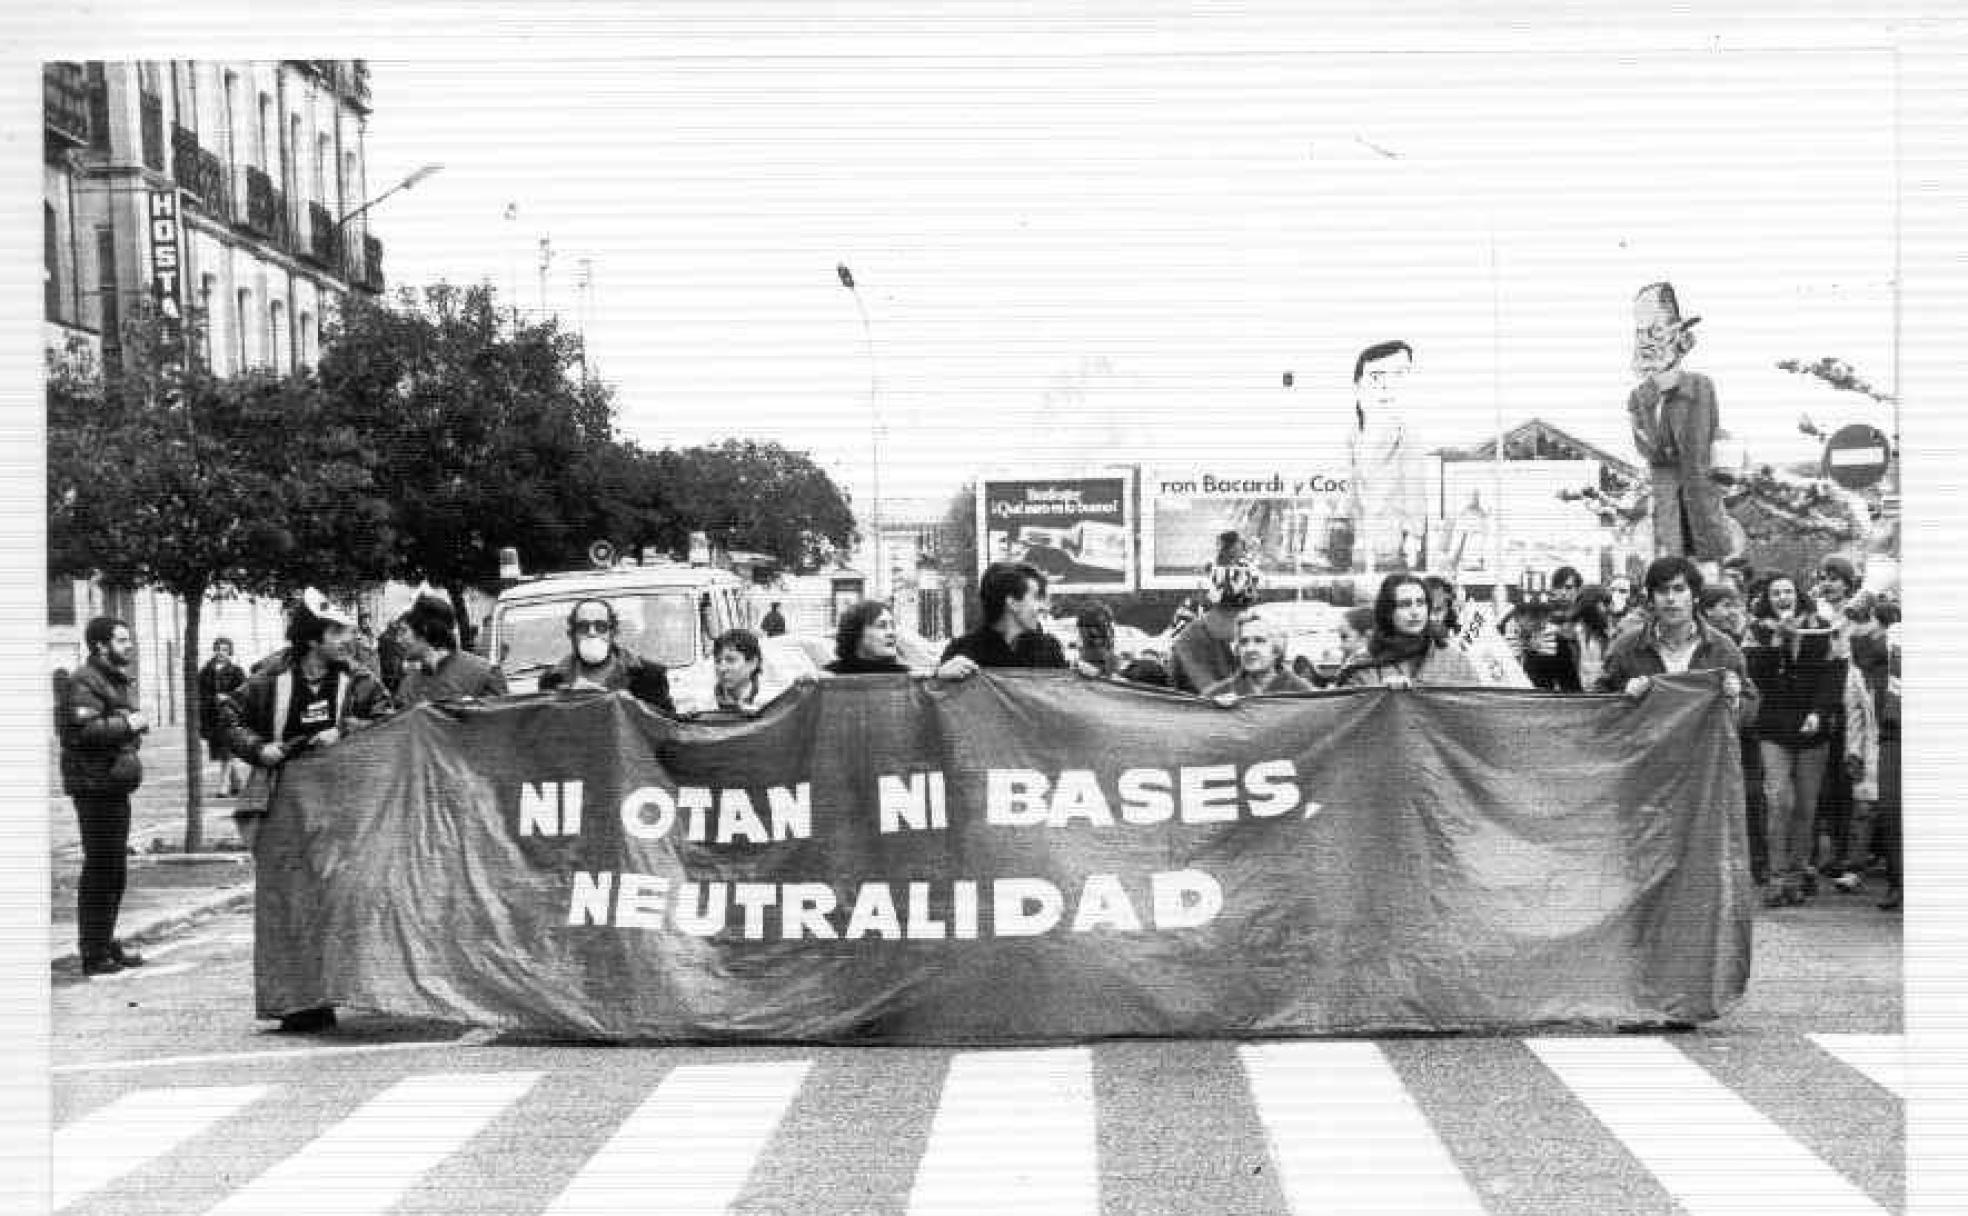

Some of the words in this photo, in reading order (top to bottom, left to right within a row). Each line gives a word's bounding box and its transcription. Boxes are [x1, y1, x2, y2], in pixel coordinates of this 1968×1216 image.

[1161, 480, 1197, 494] ron
[1203, 473, 1284, 493] Bacardi
[1294, 480, 1304, 496] y
[519, 780, 584, 837] NI
[620, 781, 812, 843] OTAN
[878, 770, 948, 834] NI
[985, 759, 1323, 828] BASES,
[568, 868, 1224, 940] NEUTRALIDAD
